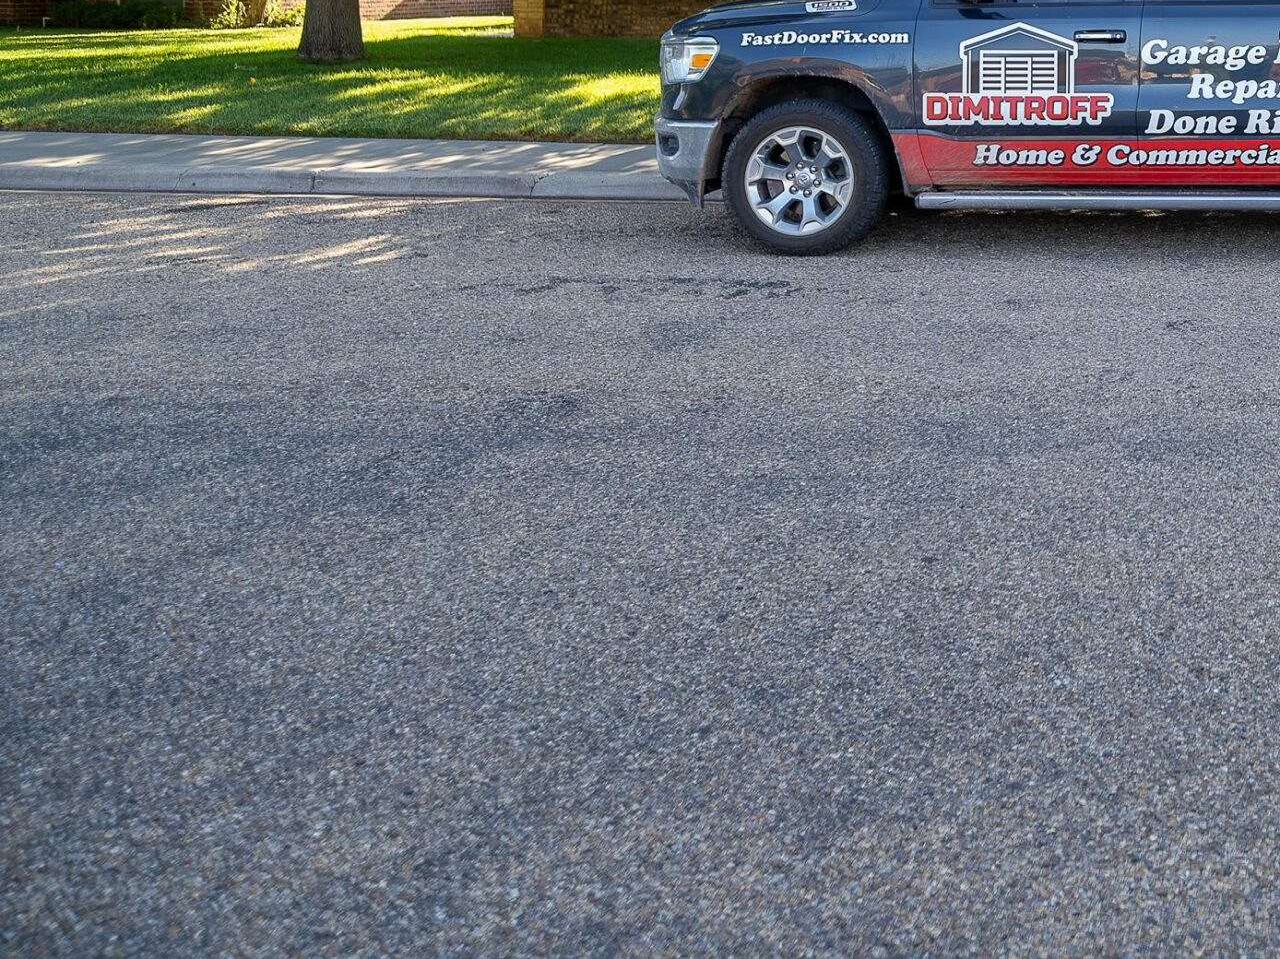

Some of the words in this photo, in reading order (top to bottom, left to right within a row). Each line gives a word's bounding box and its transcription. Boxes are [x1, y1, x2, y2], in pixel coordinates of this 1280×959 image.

[740, 30, 909, 46] FastDoorFix.com
[1141, 39, 1267, 70] Garage
[926, 95, 1111, 122] DIMITROFF
[1145, 109, 1237, 134] Done
[973, 144, 1064, 166] Home
[1071, 144, 1101, 166] &
